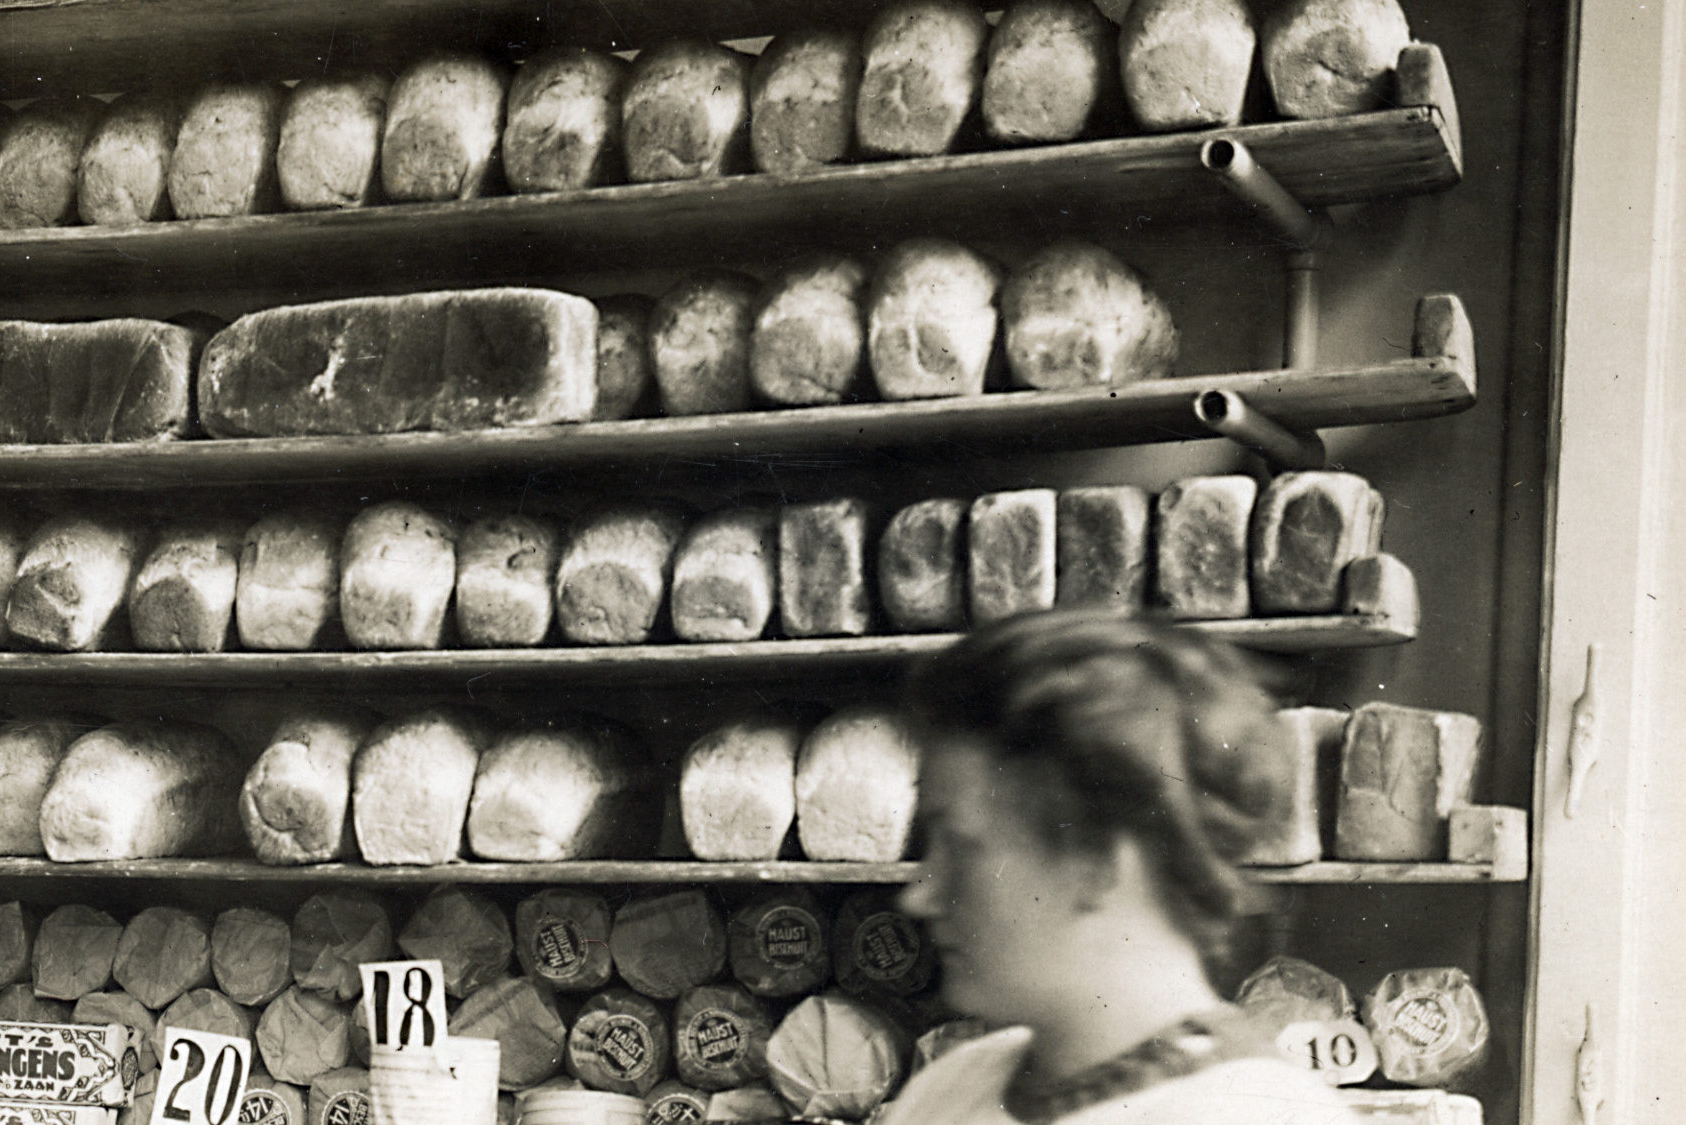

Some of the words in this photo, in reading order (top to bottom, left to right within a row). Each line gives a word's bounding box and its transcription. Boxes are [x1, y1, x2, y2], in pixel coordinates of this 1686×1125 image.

[769, 926, 806, 942] HAUST
[374, 967, 435, 1046] 18
[611, 1027, 645, 1059] HAUST
[697, 1022, 733, 1045] HAUST
[1306, 1033, 1357, 1070] 10
[14, 1079, 54, 1092] ZAAN
[245, 1096, 269, 1121] 14
[329, 1103, 350, 1125] 14
